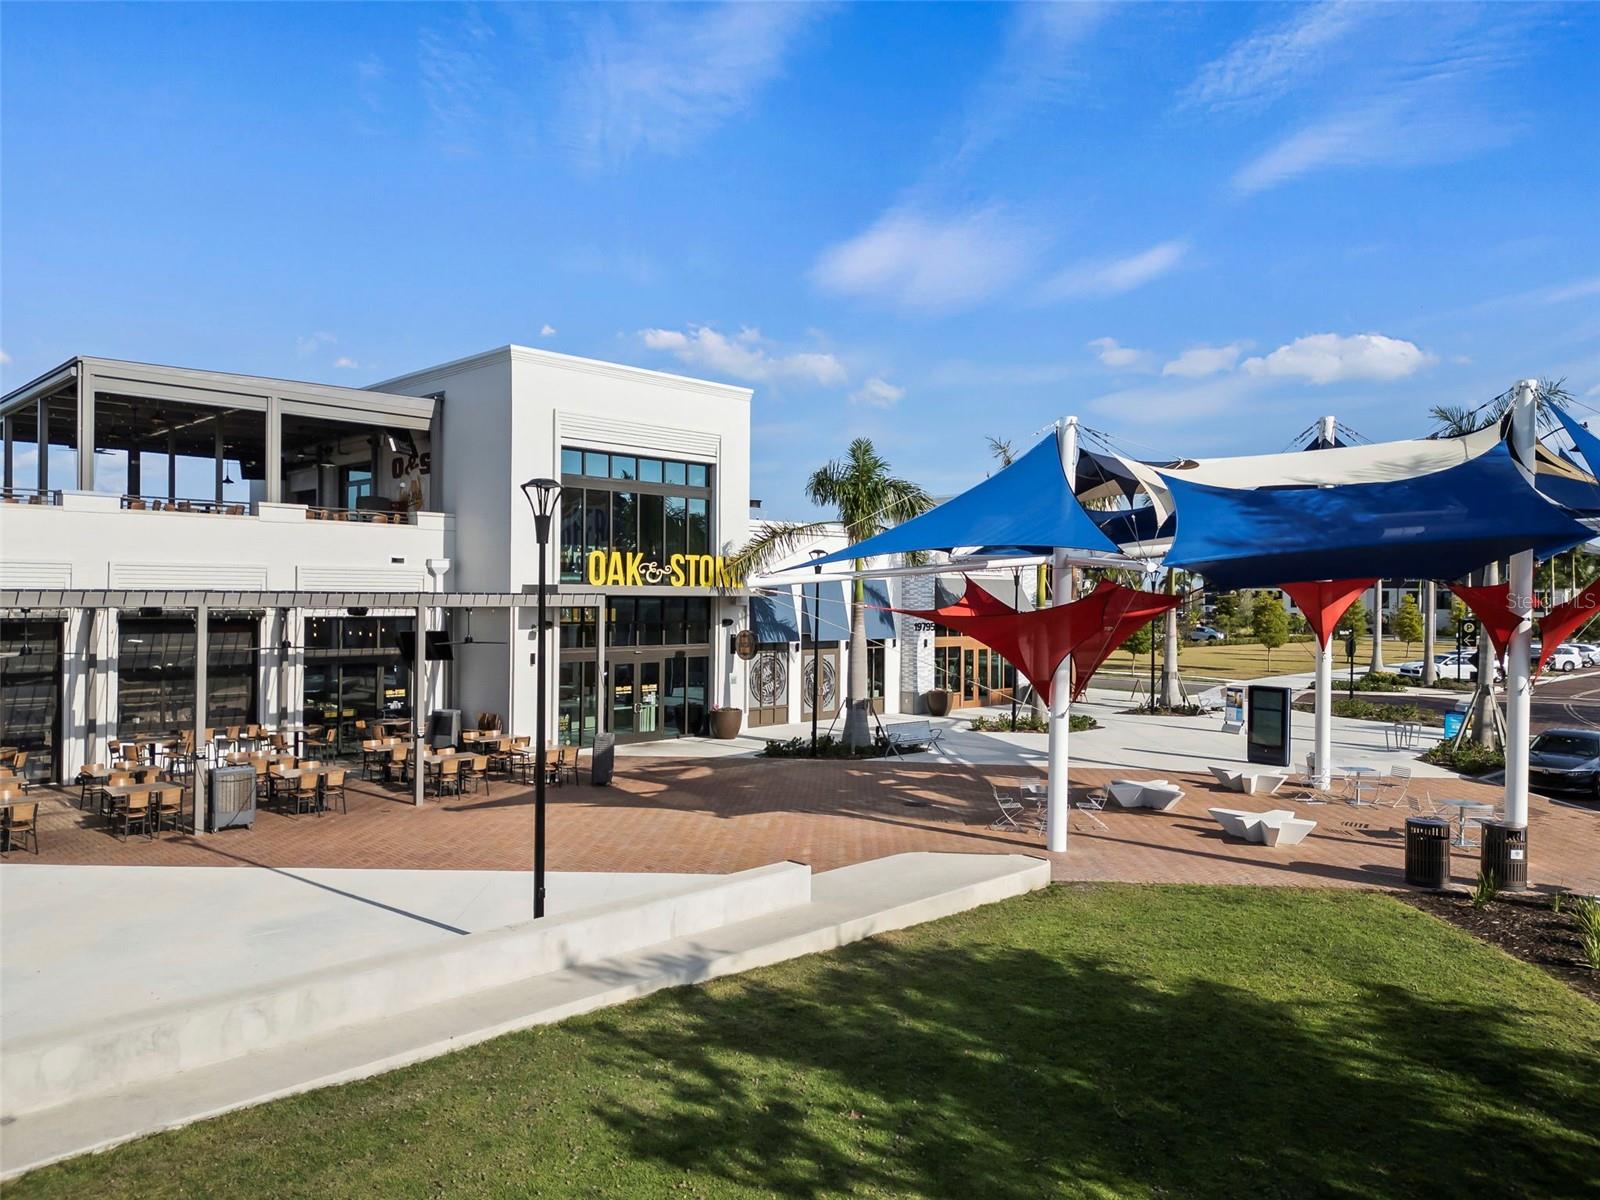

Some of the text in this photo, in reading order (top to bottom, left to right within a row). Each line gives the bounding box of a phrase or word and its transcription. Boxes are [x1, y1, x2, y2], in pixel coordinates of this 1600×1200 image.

[588, 550, 644, 587] OAK
[638, 561, 672, 584] &
[914, 622, 936, 632] 19795
